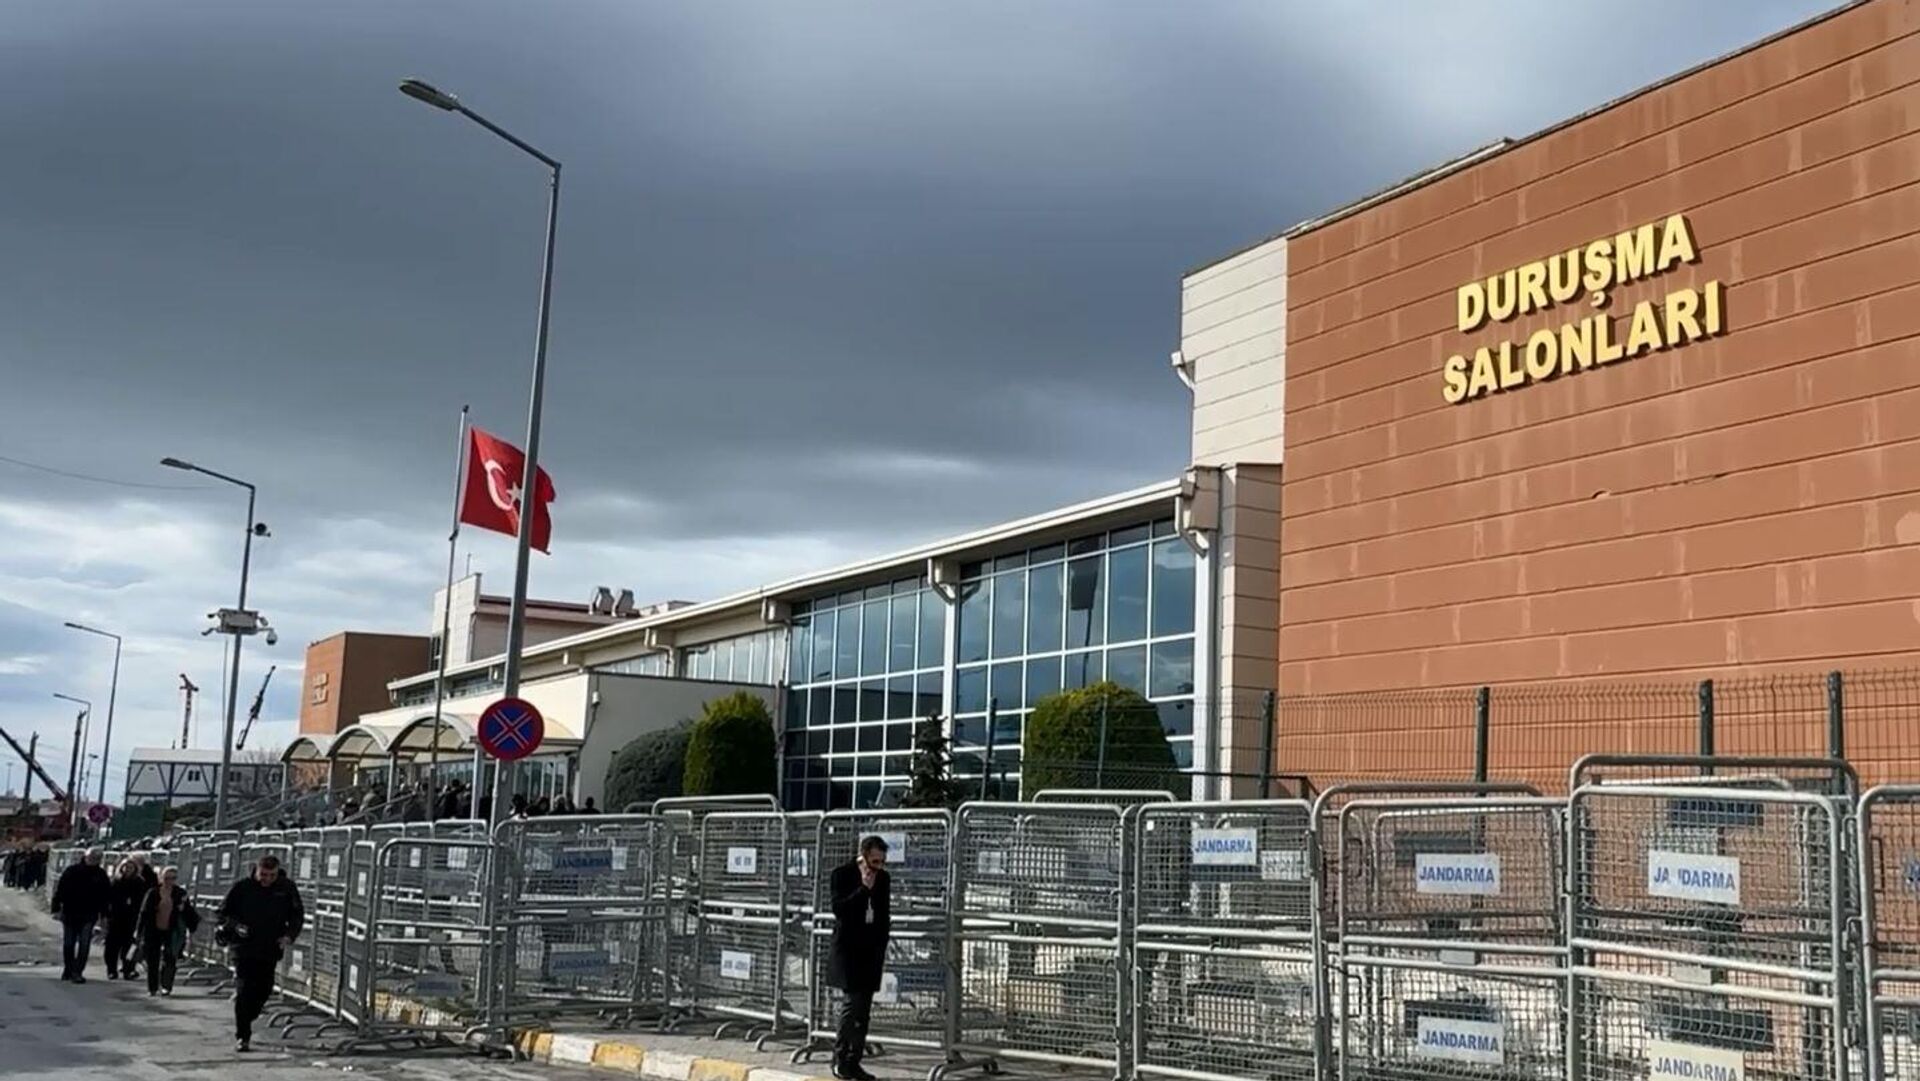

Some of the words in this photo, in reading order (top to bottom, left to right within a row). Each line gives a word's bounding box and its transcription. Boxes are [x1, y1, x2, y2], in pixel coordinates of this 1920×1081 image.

[1457, 213, 1696, 332] DURUŞMA
[1442, 279, 1721, 404] SALONLARI
[1195, 838, 1254, 853] JANDARMA
[1419, 866, 1495, 883] JANDARMA
[1422, 1029, 1499, 1052] JANDARMA
[1655, 1056, 1738, 1081] JANDARMA
